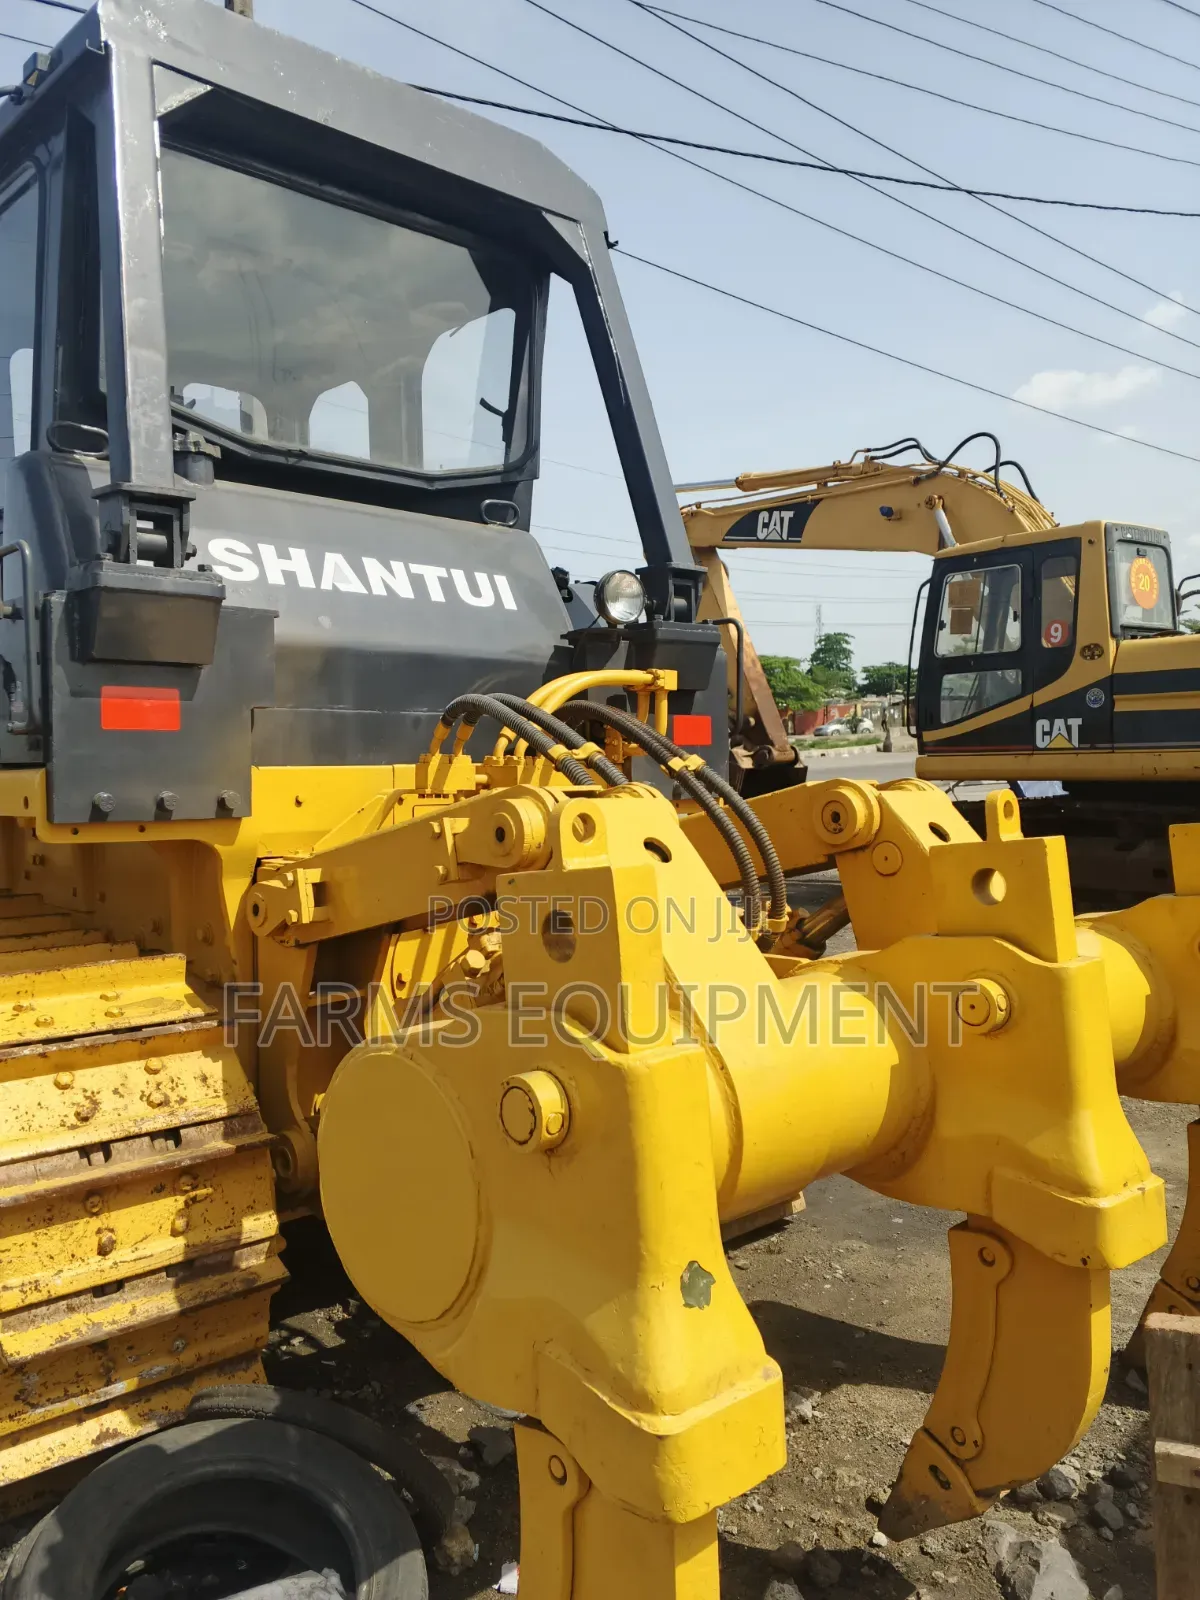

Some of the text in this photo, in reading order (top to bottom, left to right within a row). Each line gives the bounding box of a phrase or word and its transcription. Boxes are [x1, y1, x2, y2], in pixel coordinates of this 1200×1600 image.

[757, 511, 795, 540] CAT
[207, 538, 517, 610] SHANTUI
[1139, 573, 1151, 592] 20
[1050, 623, 1062, 643] 9
[1035, 718, 1082, 748] CAT
